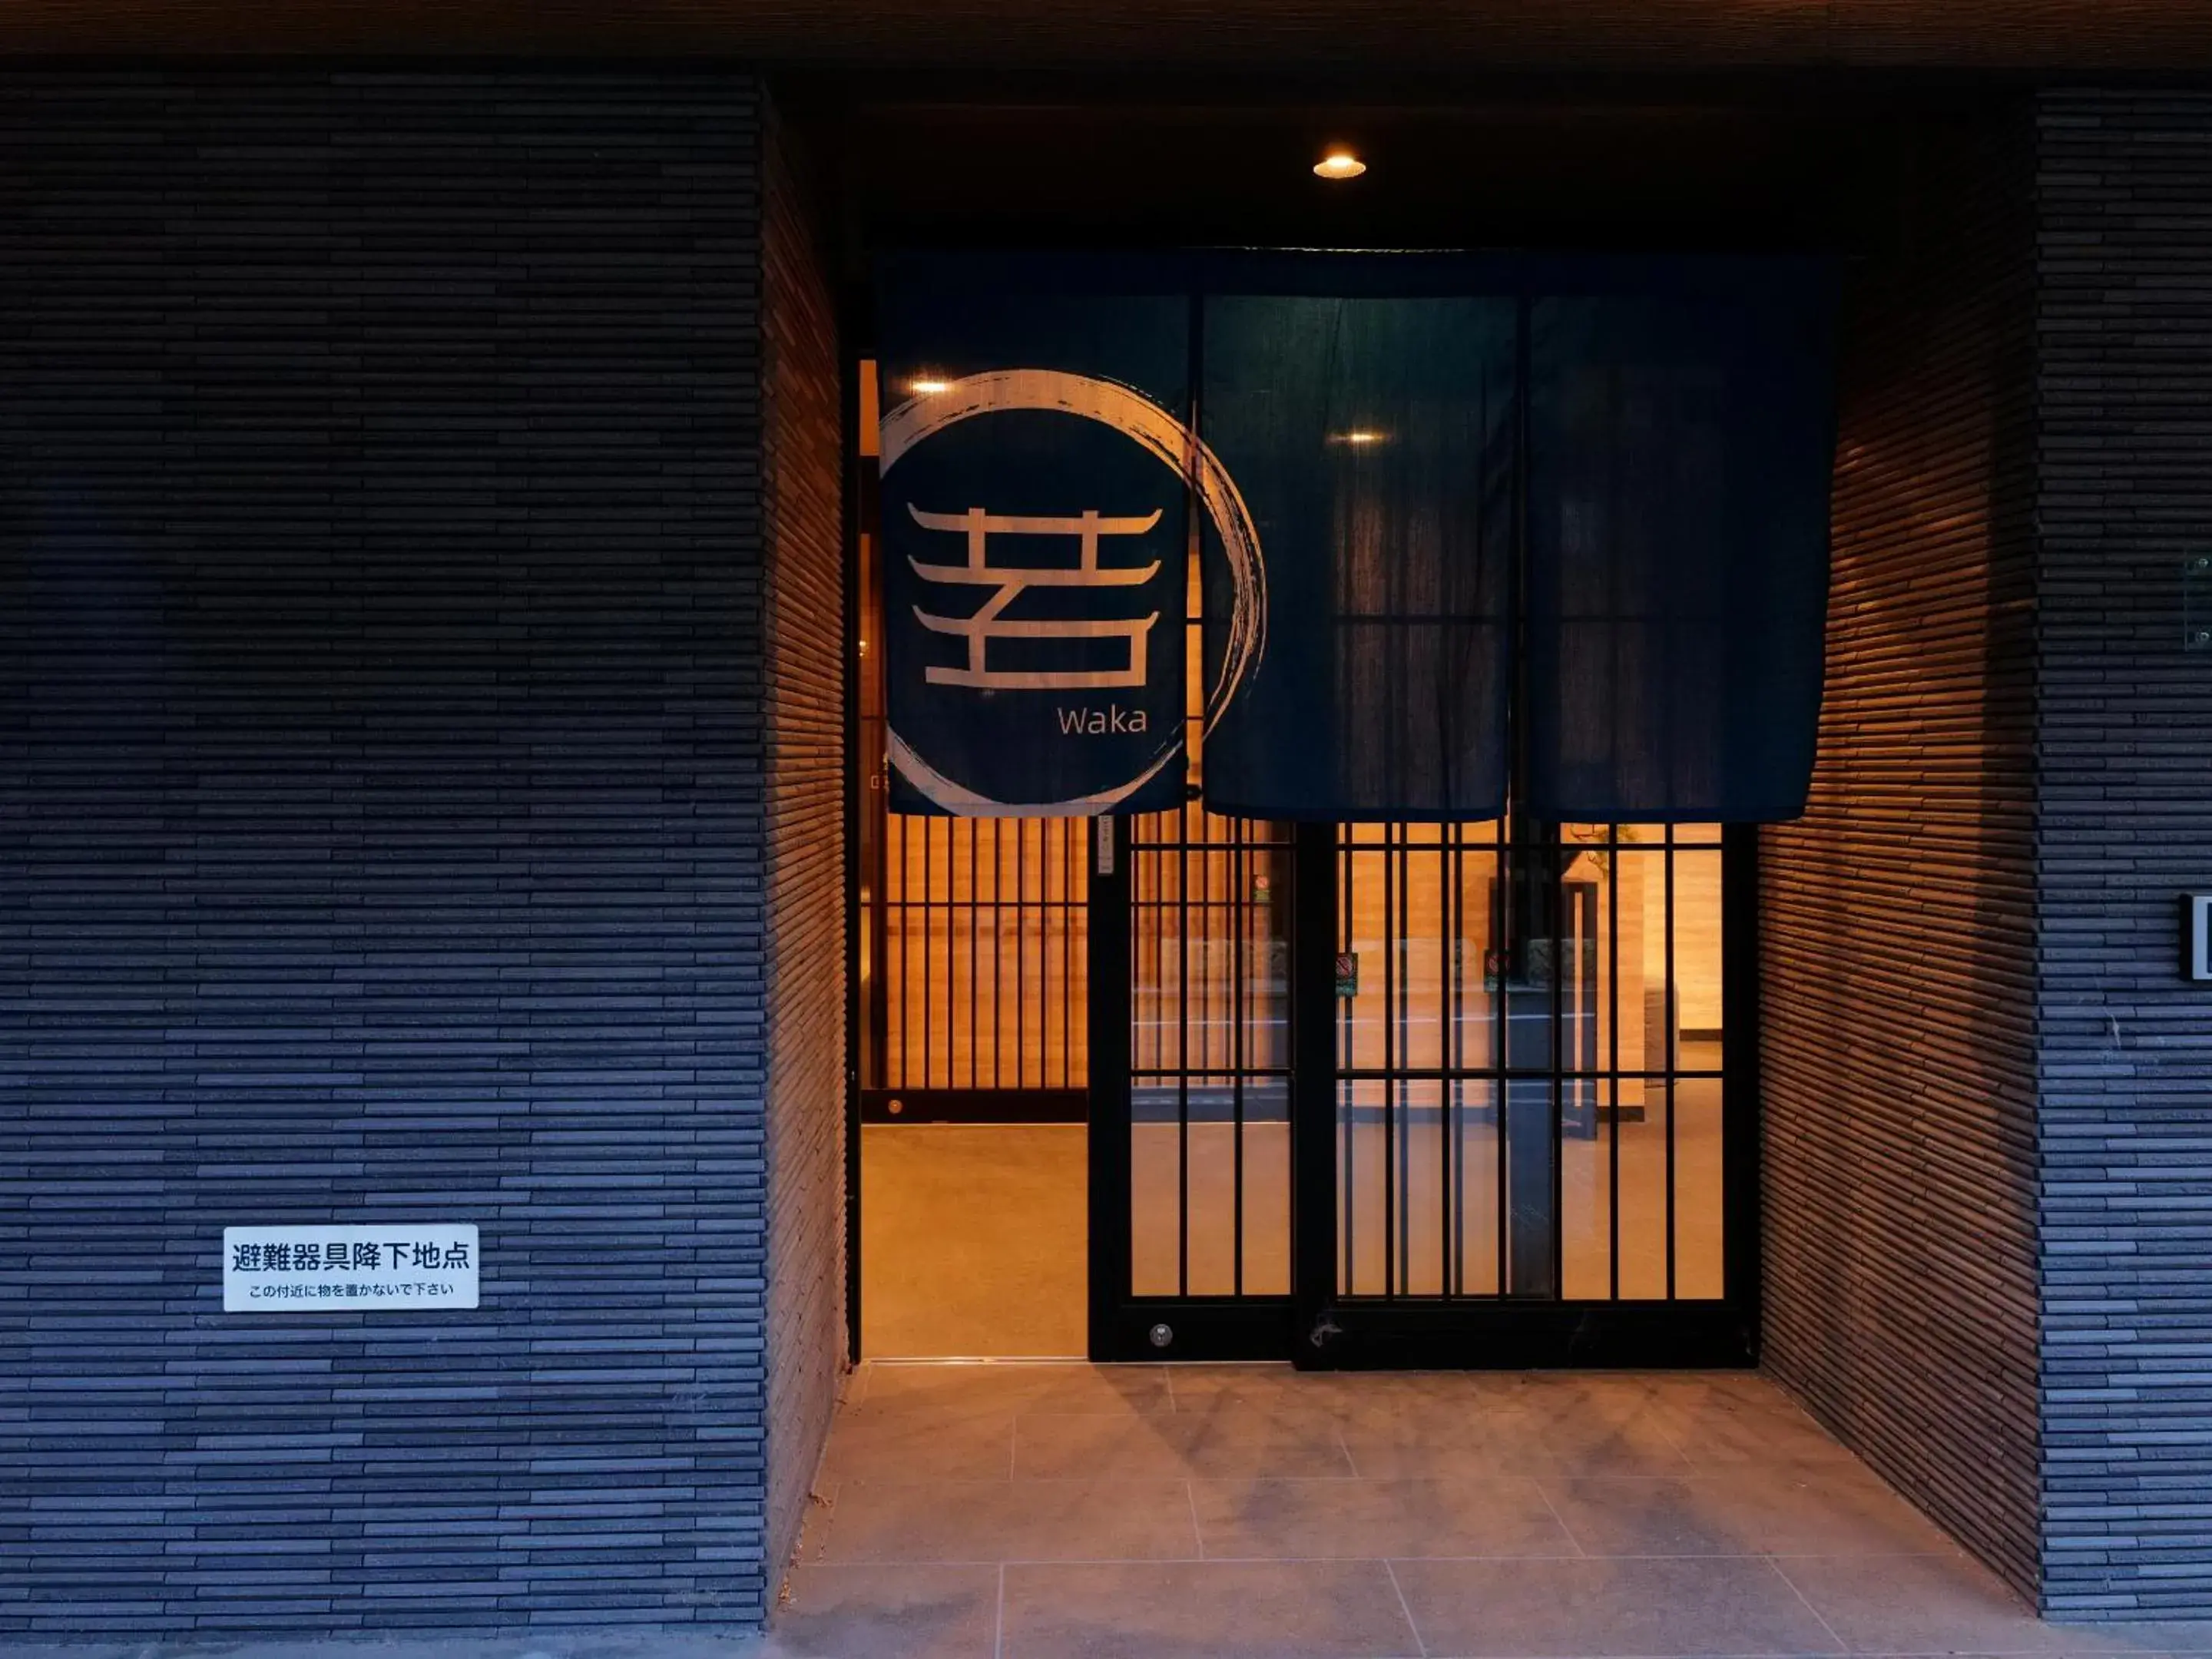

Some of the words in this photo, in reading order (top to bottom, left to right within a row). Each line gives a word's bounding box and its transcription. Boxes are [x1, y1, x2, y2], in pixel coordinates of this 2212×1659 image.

[1057, 703, 1147, 735] Waka
[232, 1241, 470, 1272] 避難器具降下地点
[250, 1282, 454, 1299] この付近に物を置かないで下さい
